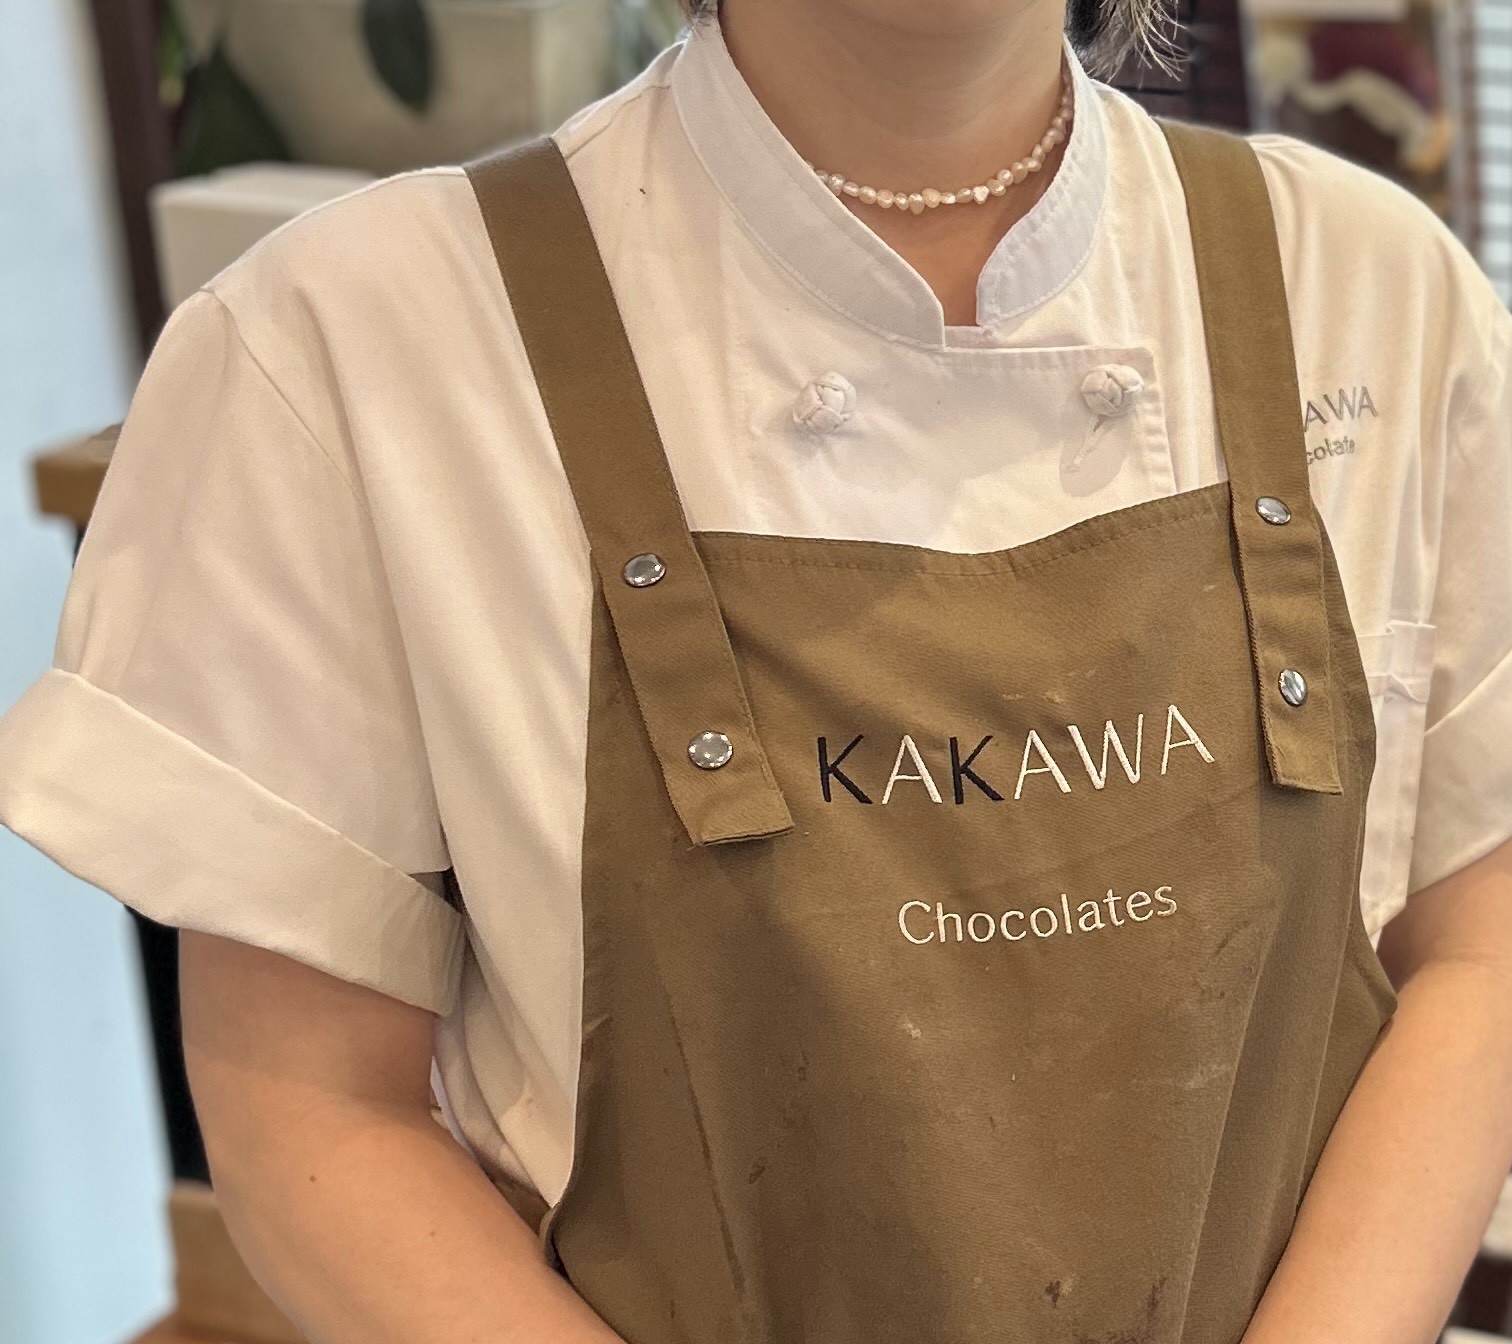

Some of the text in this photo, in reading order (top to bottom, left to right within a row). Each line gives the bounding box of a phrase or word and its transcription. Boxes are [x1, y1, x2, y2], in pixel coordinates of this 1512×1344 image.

[1304, 385, 1379, 433] AWA
[816, 703, 1216, 805] KAKAWA
[897, 884, 1178, 946] Chocolates
